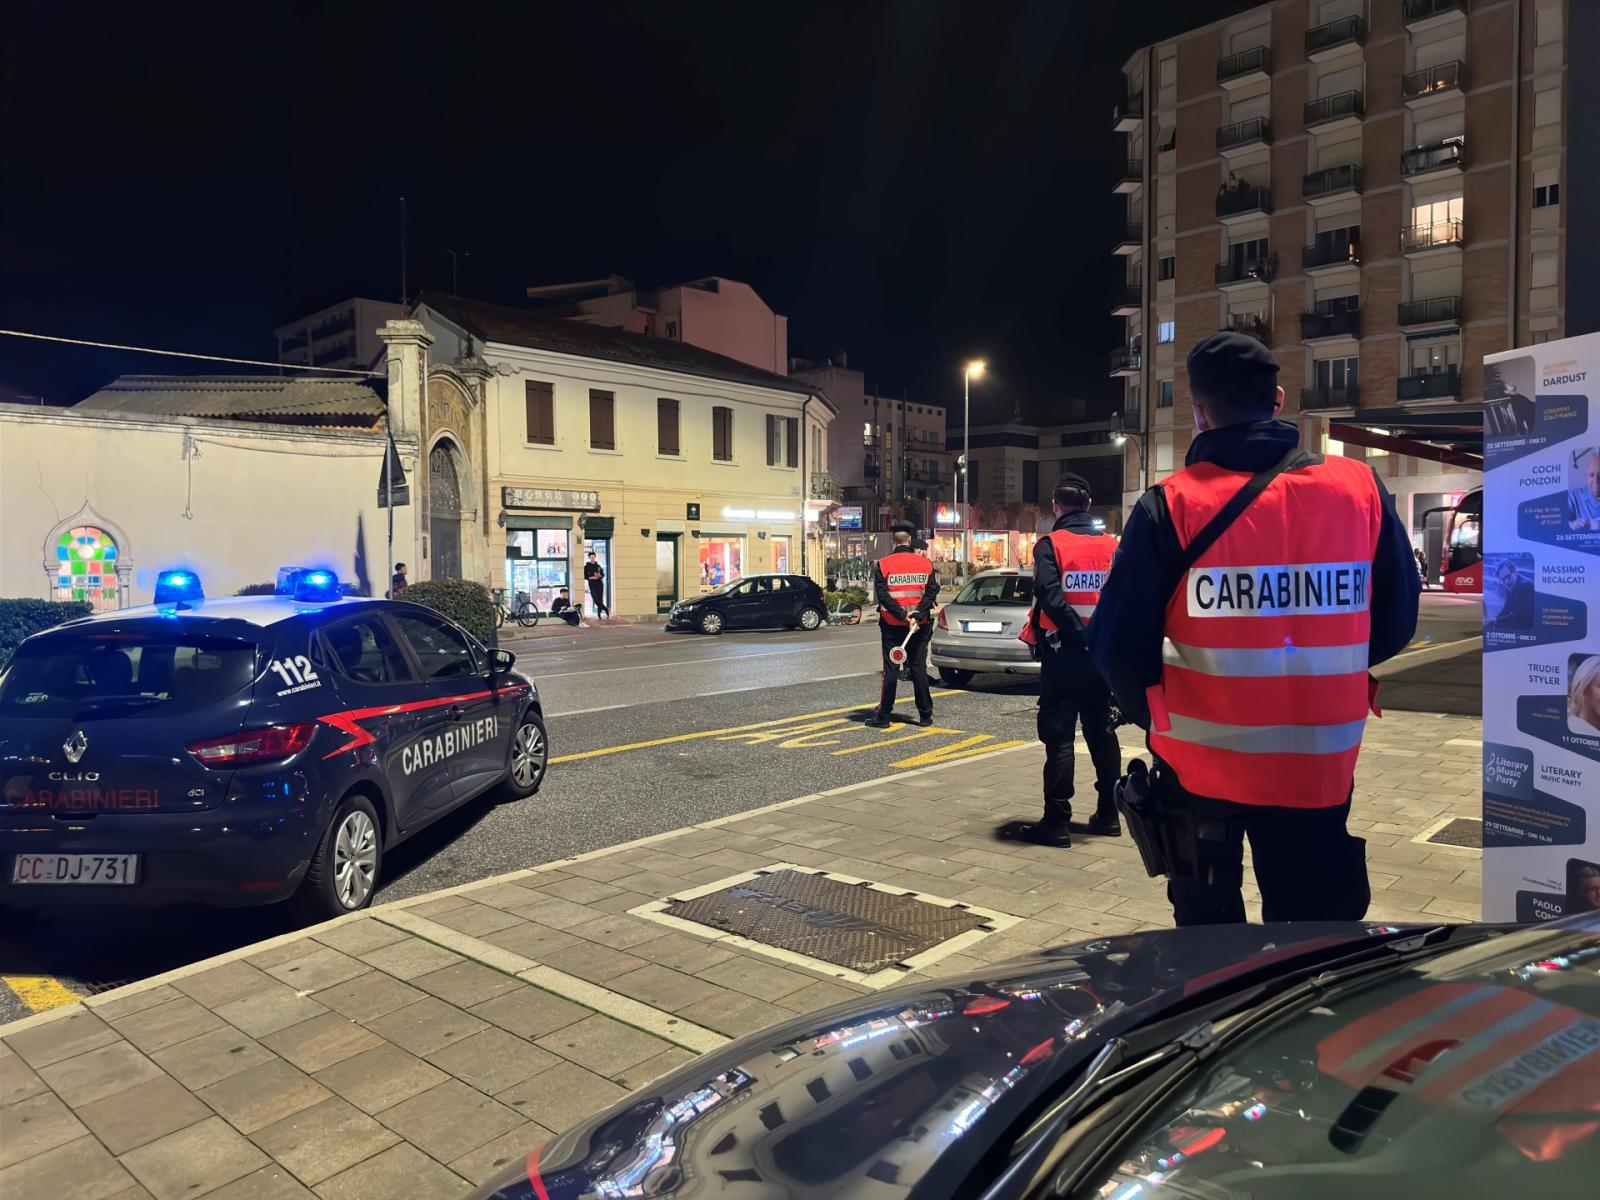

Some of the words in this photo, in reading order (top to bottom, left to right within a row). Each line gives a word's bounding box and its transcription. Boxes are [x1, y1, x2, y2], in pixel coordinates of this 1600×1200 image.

[1543, 372, 1587, 388] DARDUST
[1494, 438, 1526, 448] SETTEMBRE
[1532, 463, 1561, 474] COCHI
[1519, 475, 1561, 487] PONZONI
[1542, 565, 1585, 575] MASSIMO
[1542, 576, 1585, 584] RECALCATI
[1194, 566, 1367, 611] CARABINIERI
[1491, 632, 1517, 640] OTTOBRE
[270, 654, 319, 686] 112
[1528, 663, 1560, 674] TRUDIE
[1528, 674, 1560, 686] STYLER
[276, 680, 322, 697] www.carabinieri.it
[402, 715, 498, 776] CARABINIERI
[1570, 736, 1600, 747] OTTOBRE
[1496, 756, 1529, 773] Literary
[48, 772, 100, 781] CLIO
[1496, 765, 1521, 778] Music
[1540, 765, 1582, 779] LITERARY
[1496, 775, 1518, 788] Party
[1540, 774, 1561, 783] MUSIC
[1561, 778, 1582, 787] PARTY
[5, 786, 160, 810] CARABINIERI
[1492, 823, 1525, 836] SETTEMBRE
[1532, 897, 1562, 913] PAOLO
